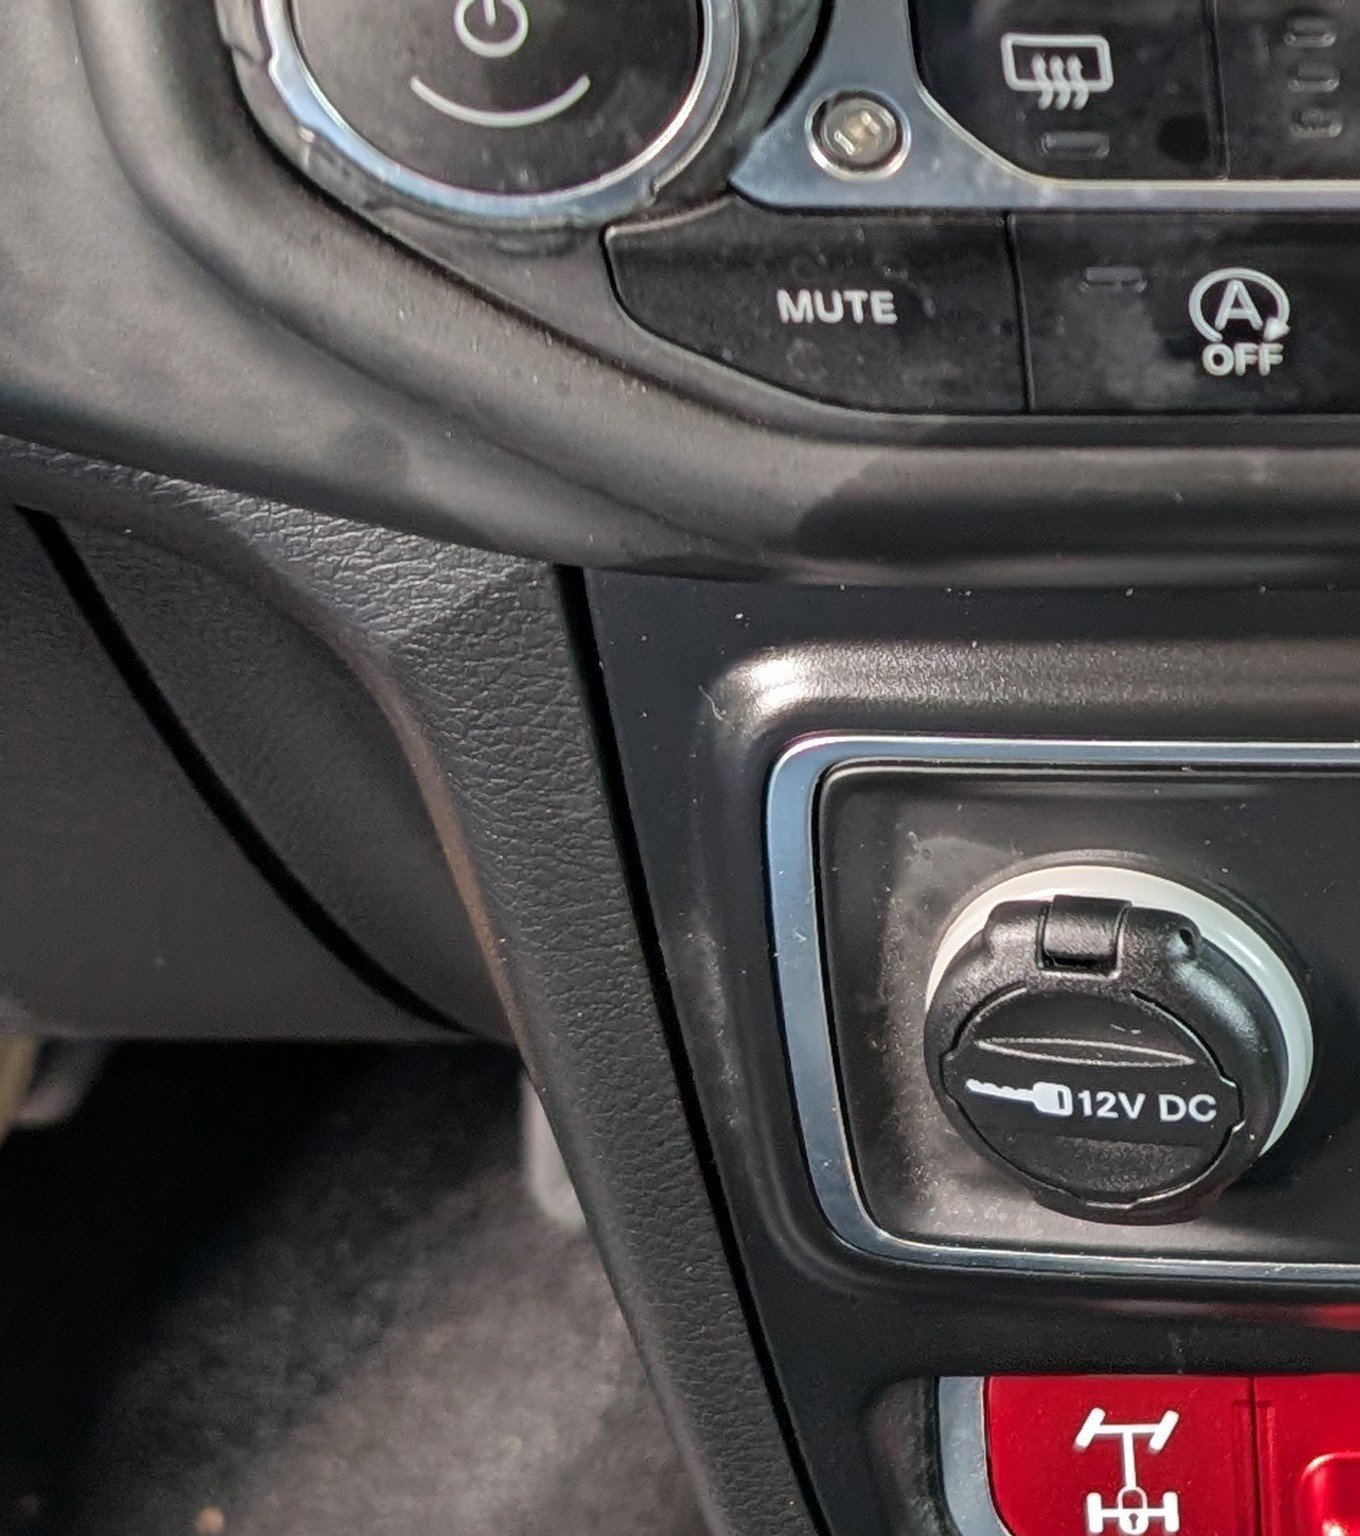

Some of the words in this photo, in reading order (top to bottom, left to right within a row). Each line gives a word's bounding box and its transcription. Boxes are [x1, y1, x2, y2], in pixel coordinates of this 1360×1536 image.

[775, 287, 898, 325] MUTE
[1202, 342, 1285, 377] OFF
[1076, 1089, 1147, 1120] 12V
[1157, 1091, 1218, 1124] DC
